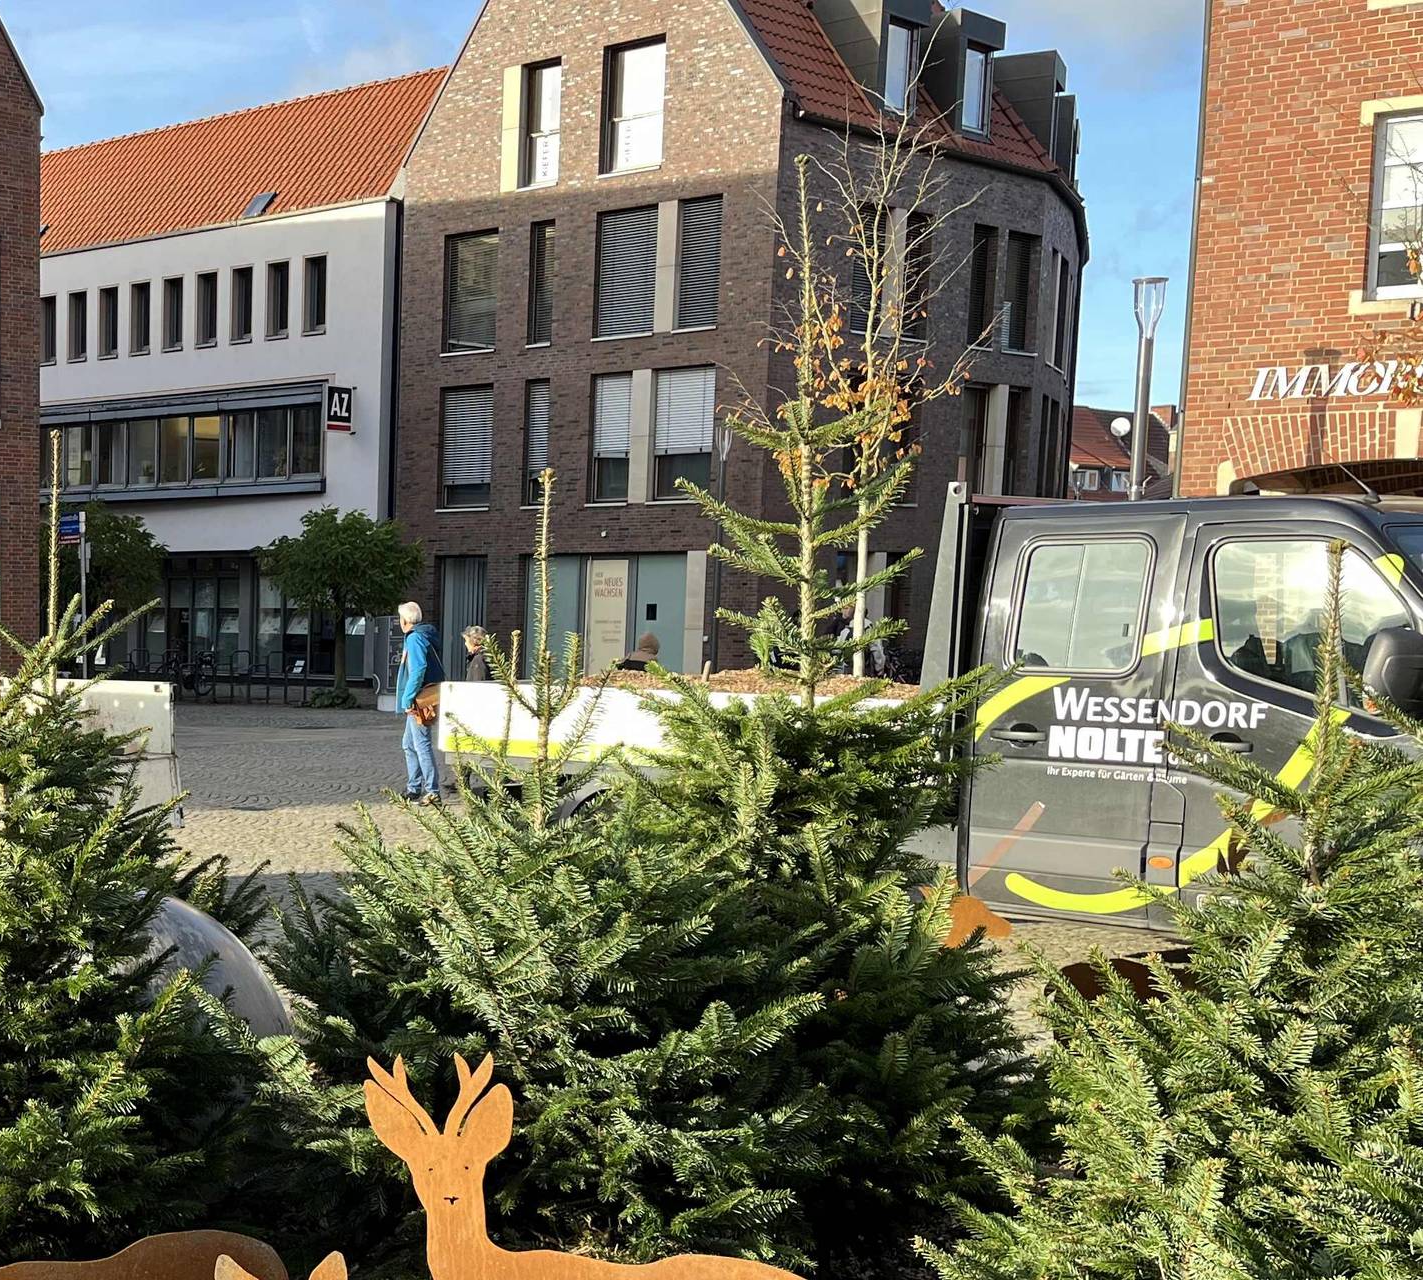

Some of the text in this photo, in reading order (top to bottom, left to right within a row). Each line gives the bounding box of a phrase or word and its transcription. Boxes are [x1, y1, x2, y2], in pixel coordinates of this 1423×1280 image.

[330, 392, 349, 417] AZ
[594, 588, 624, 598] WACHSEN
[1053, 686, 1268, 729] WESSENDORF
[1048, 726, 1165, 764] NOLTE
[1046, 766, 1058, 775] Ihr
[1061, 767, 1095, 779] Experte
[1097, 769, 1110, 779] für
[1113, 770, 1145, 781] Gärten
[1147, 773, 1155, 783] &
